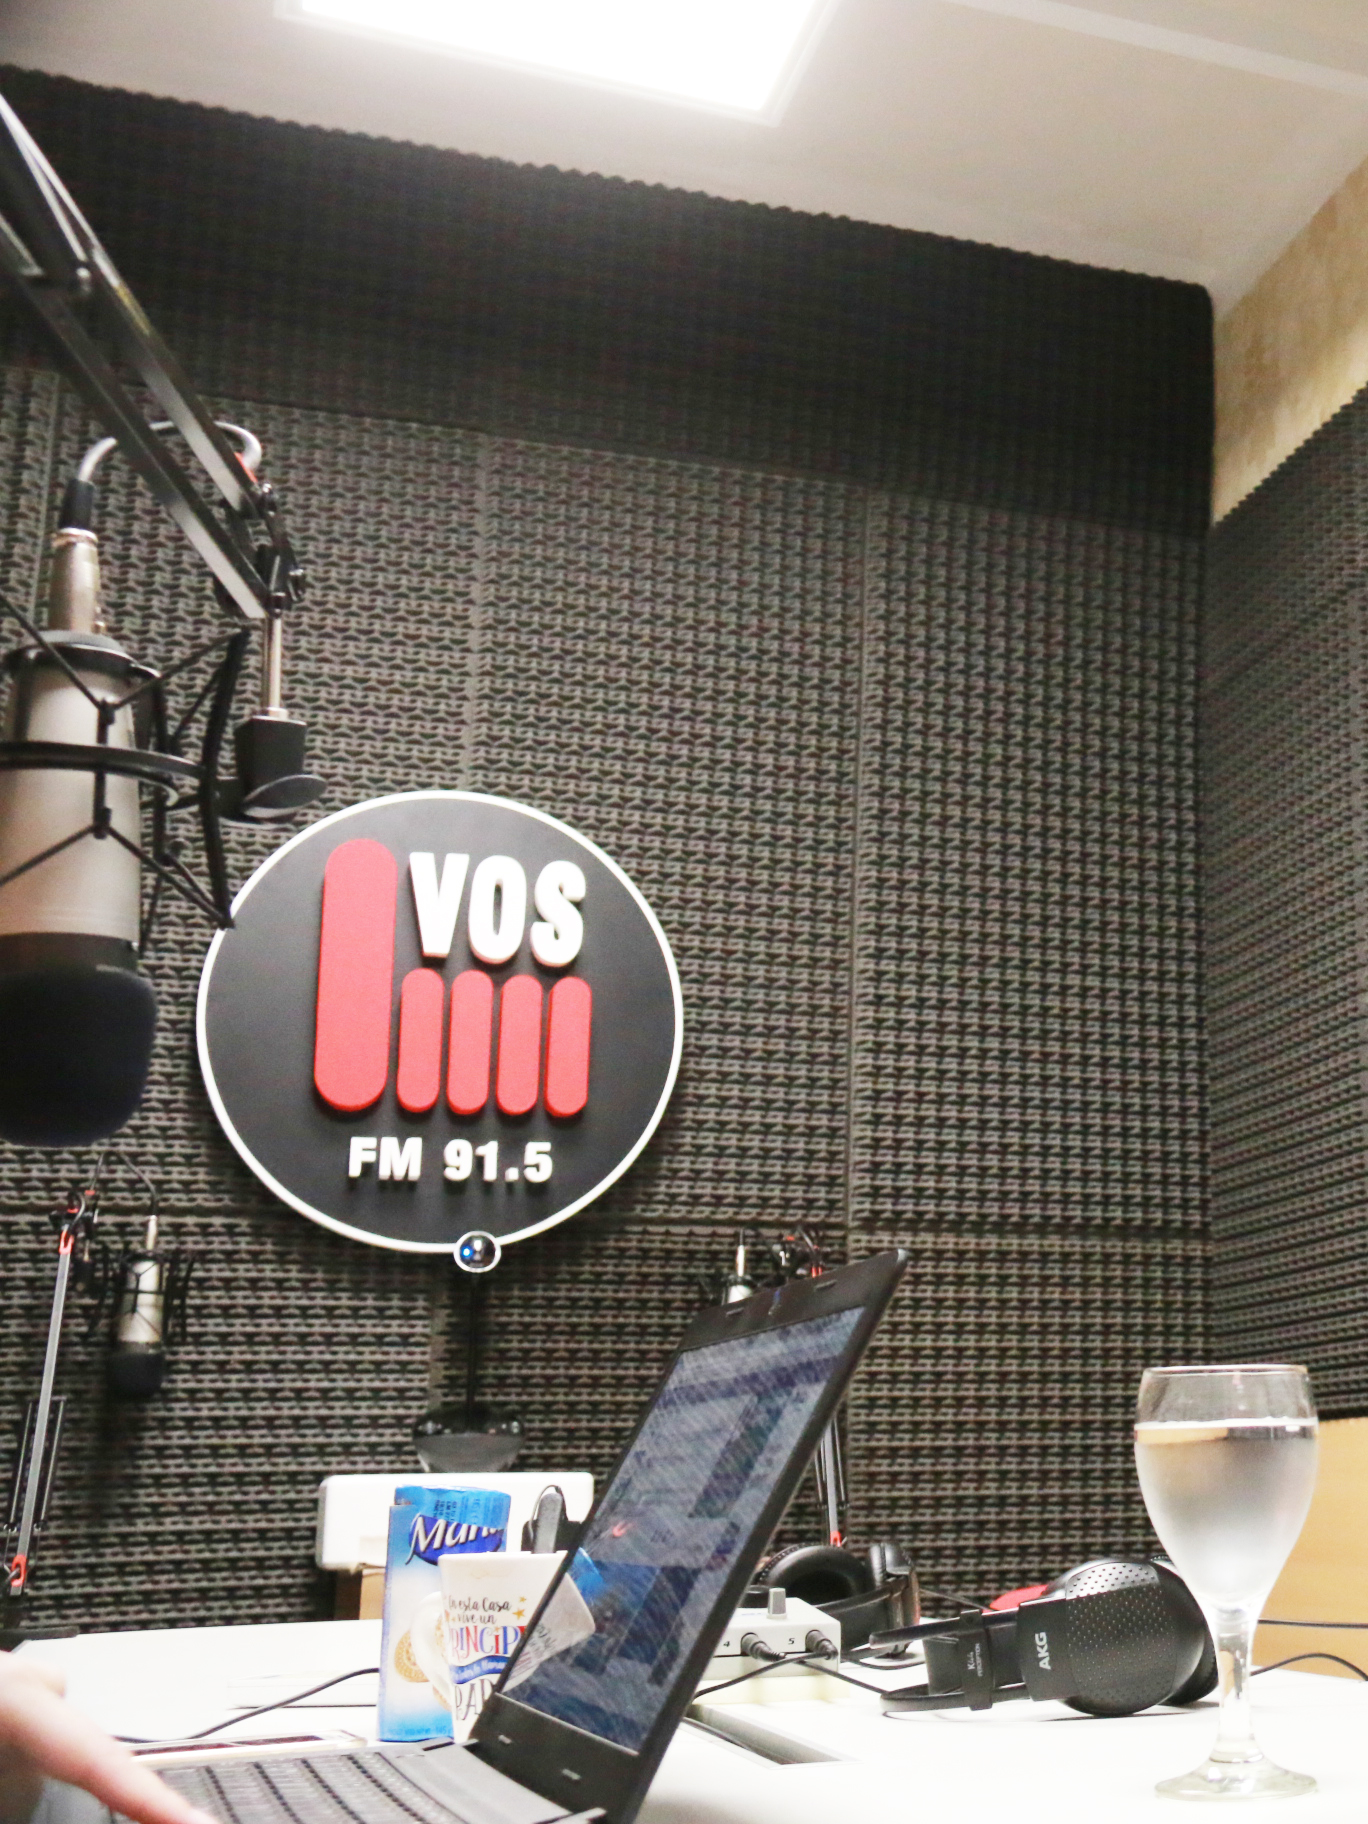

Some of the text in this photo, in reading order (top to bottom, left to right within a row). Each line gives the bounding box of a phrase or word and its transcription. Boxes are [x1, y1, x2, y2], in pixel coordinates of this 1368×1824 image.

[409, 851, 587, 968] VOS
[348, 1136, 553, 1183] FM 91.5
[458, 1596, 479, 1611] esta
[723, 1640, 731, 1648] 4
[787, 1637, 796, 1646] 5
[1034, 1631, 1052, 1670] AKG
